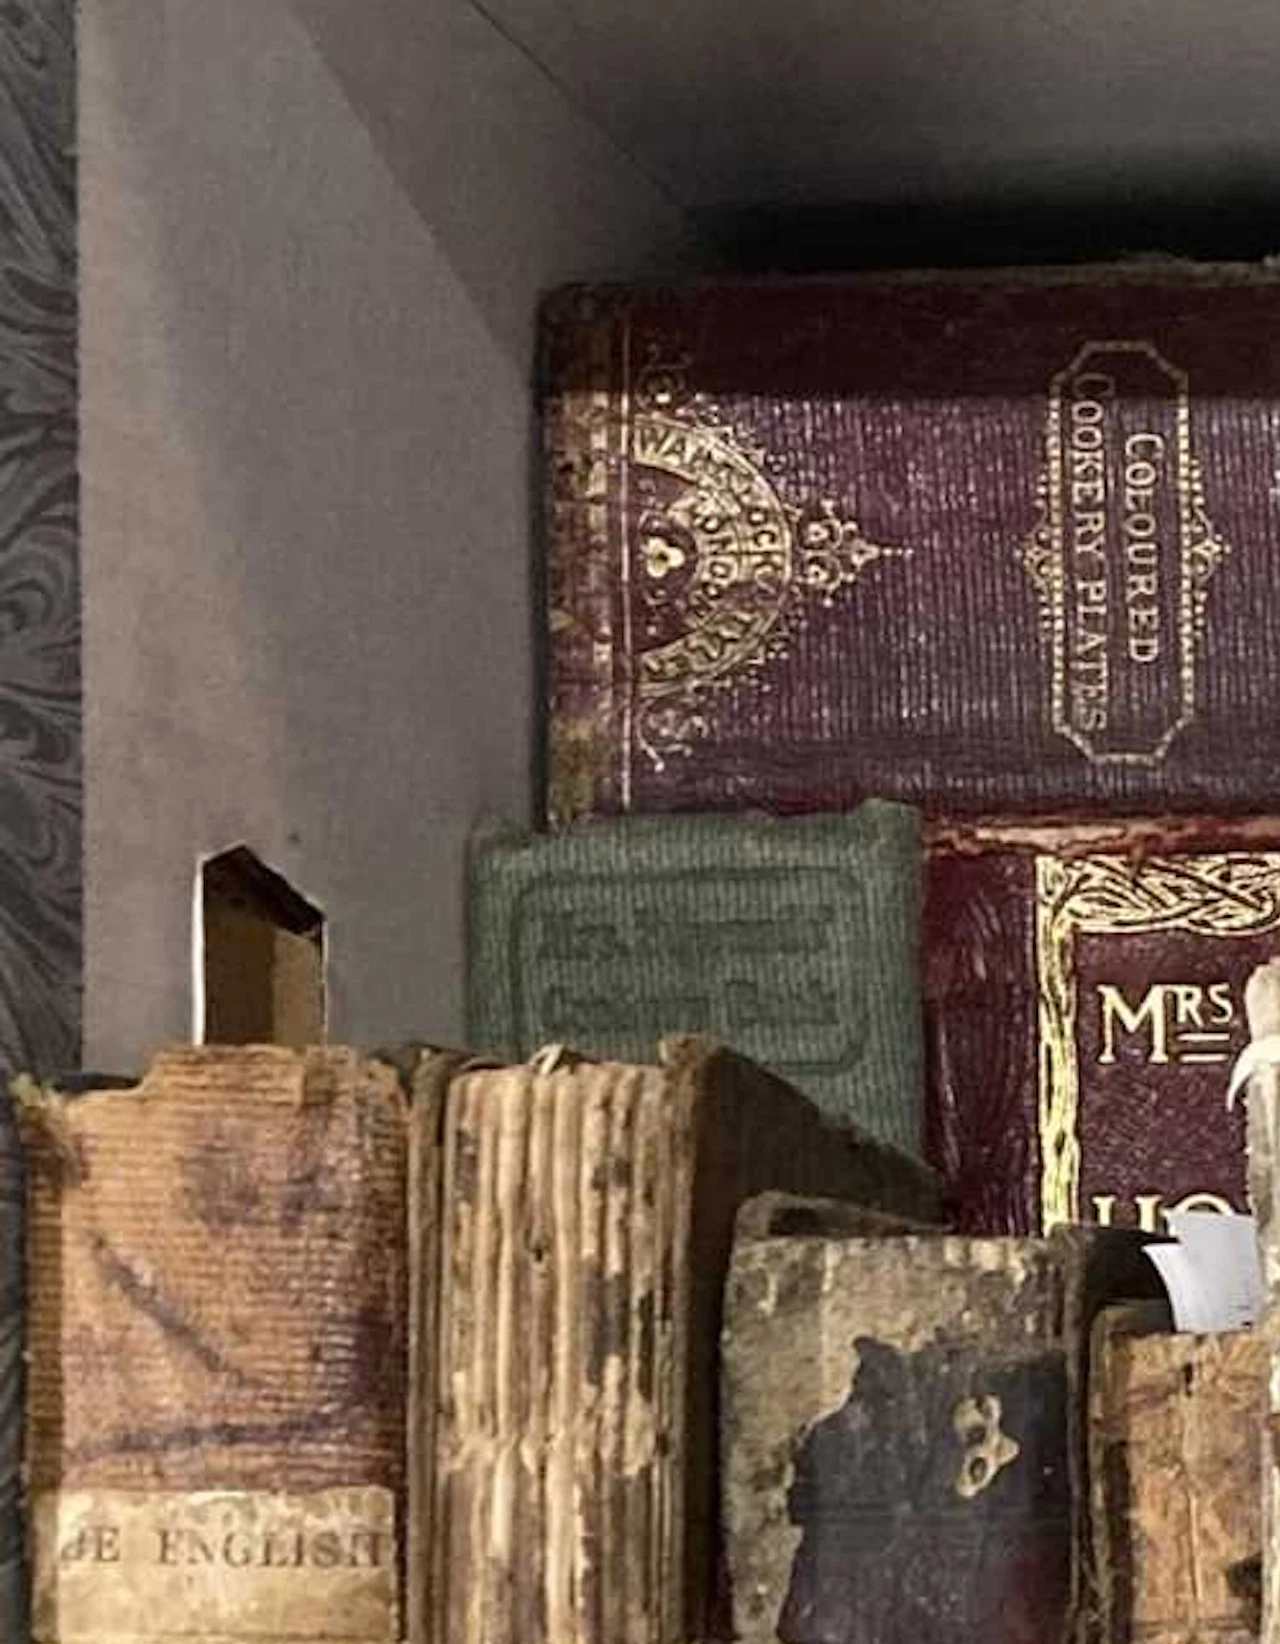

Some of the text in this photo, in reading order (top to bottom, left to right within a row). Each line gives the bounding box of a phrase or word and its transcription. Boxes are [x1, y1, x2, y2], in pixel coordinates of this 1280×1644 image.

[1070, 371, 1114, 732] COOKERY PLATES
[1124, 431, 1165, 664] COLOURED
